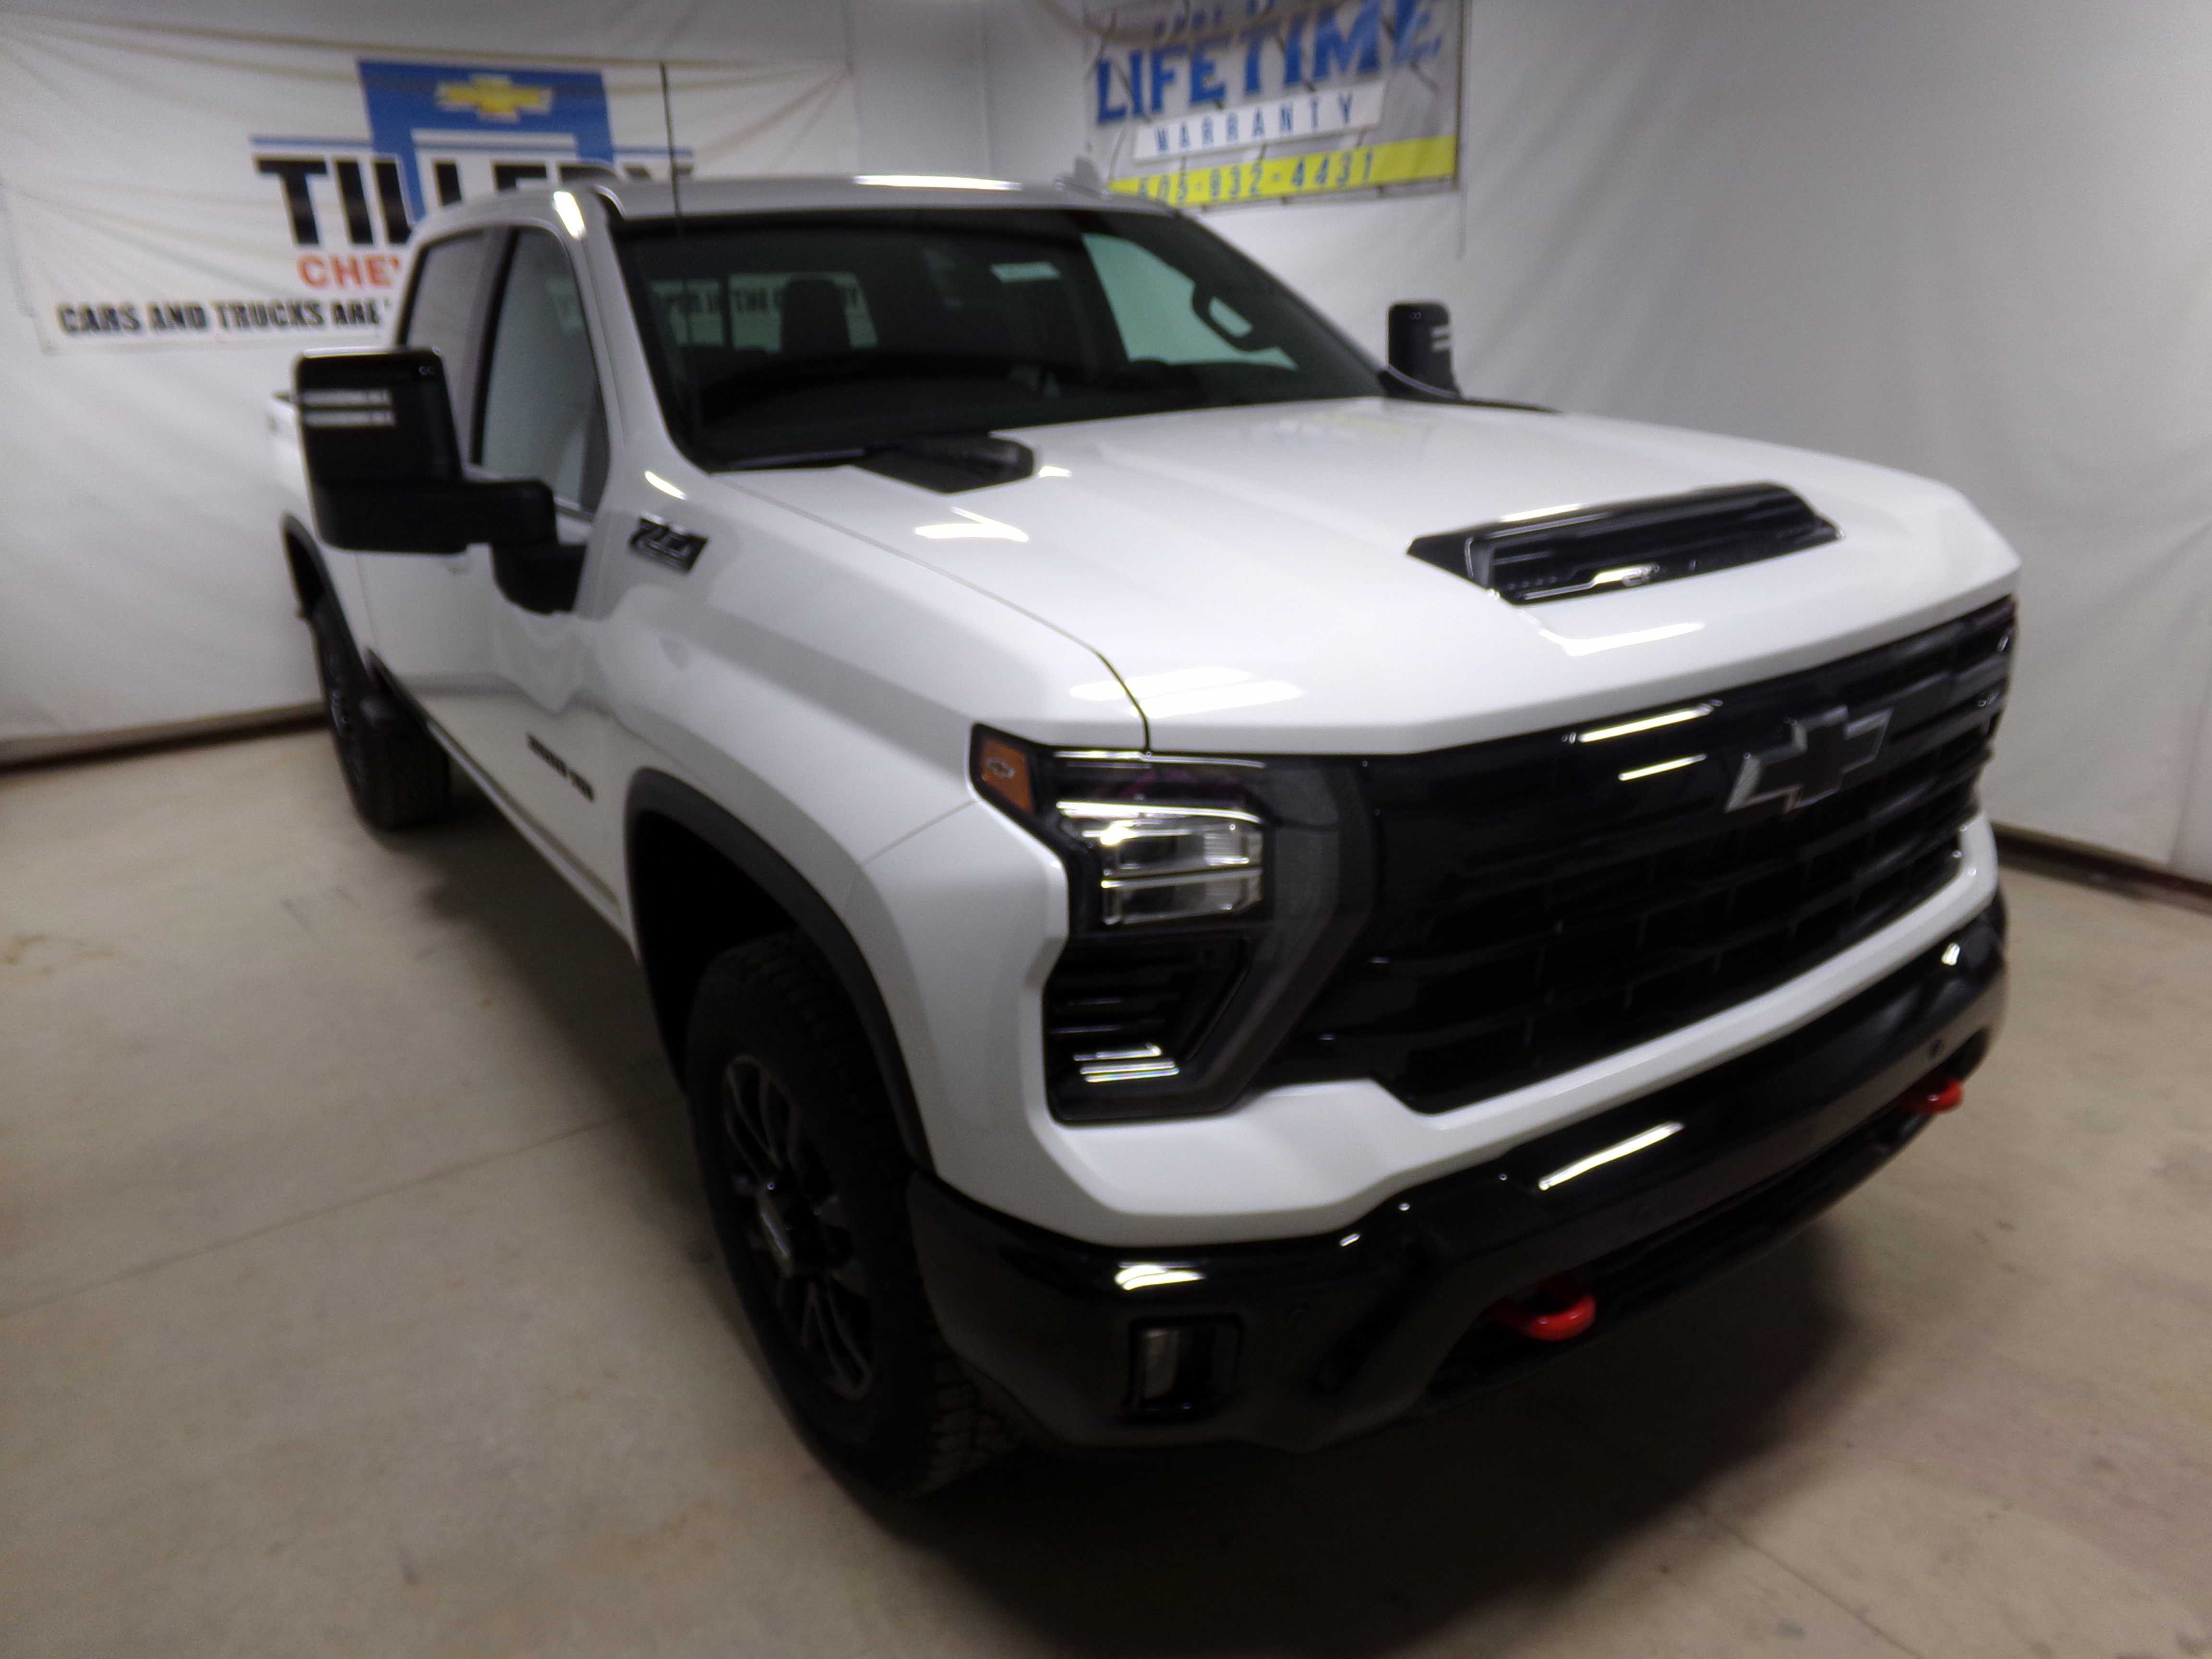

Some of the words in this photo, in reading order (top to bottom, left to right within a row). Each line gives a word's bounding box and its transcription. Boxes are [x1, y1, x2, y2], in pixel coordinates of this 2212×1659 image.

[1095, 0, 1442, 126] LIFETIME
[1156, 94, 1355, 153] WARRANTY
[57, 301, 141, 334] CARS
[148, 301, 208, 332] AND
[210, 299, 325, 330] TRUCKS
[330, 300, 380, 326] ARE
